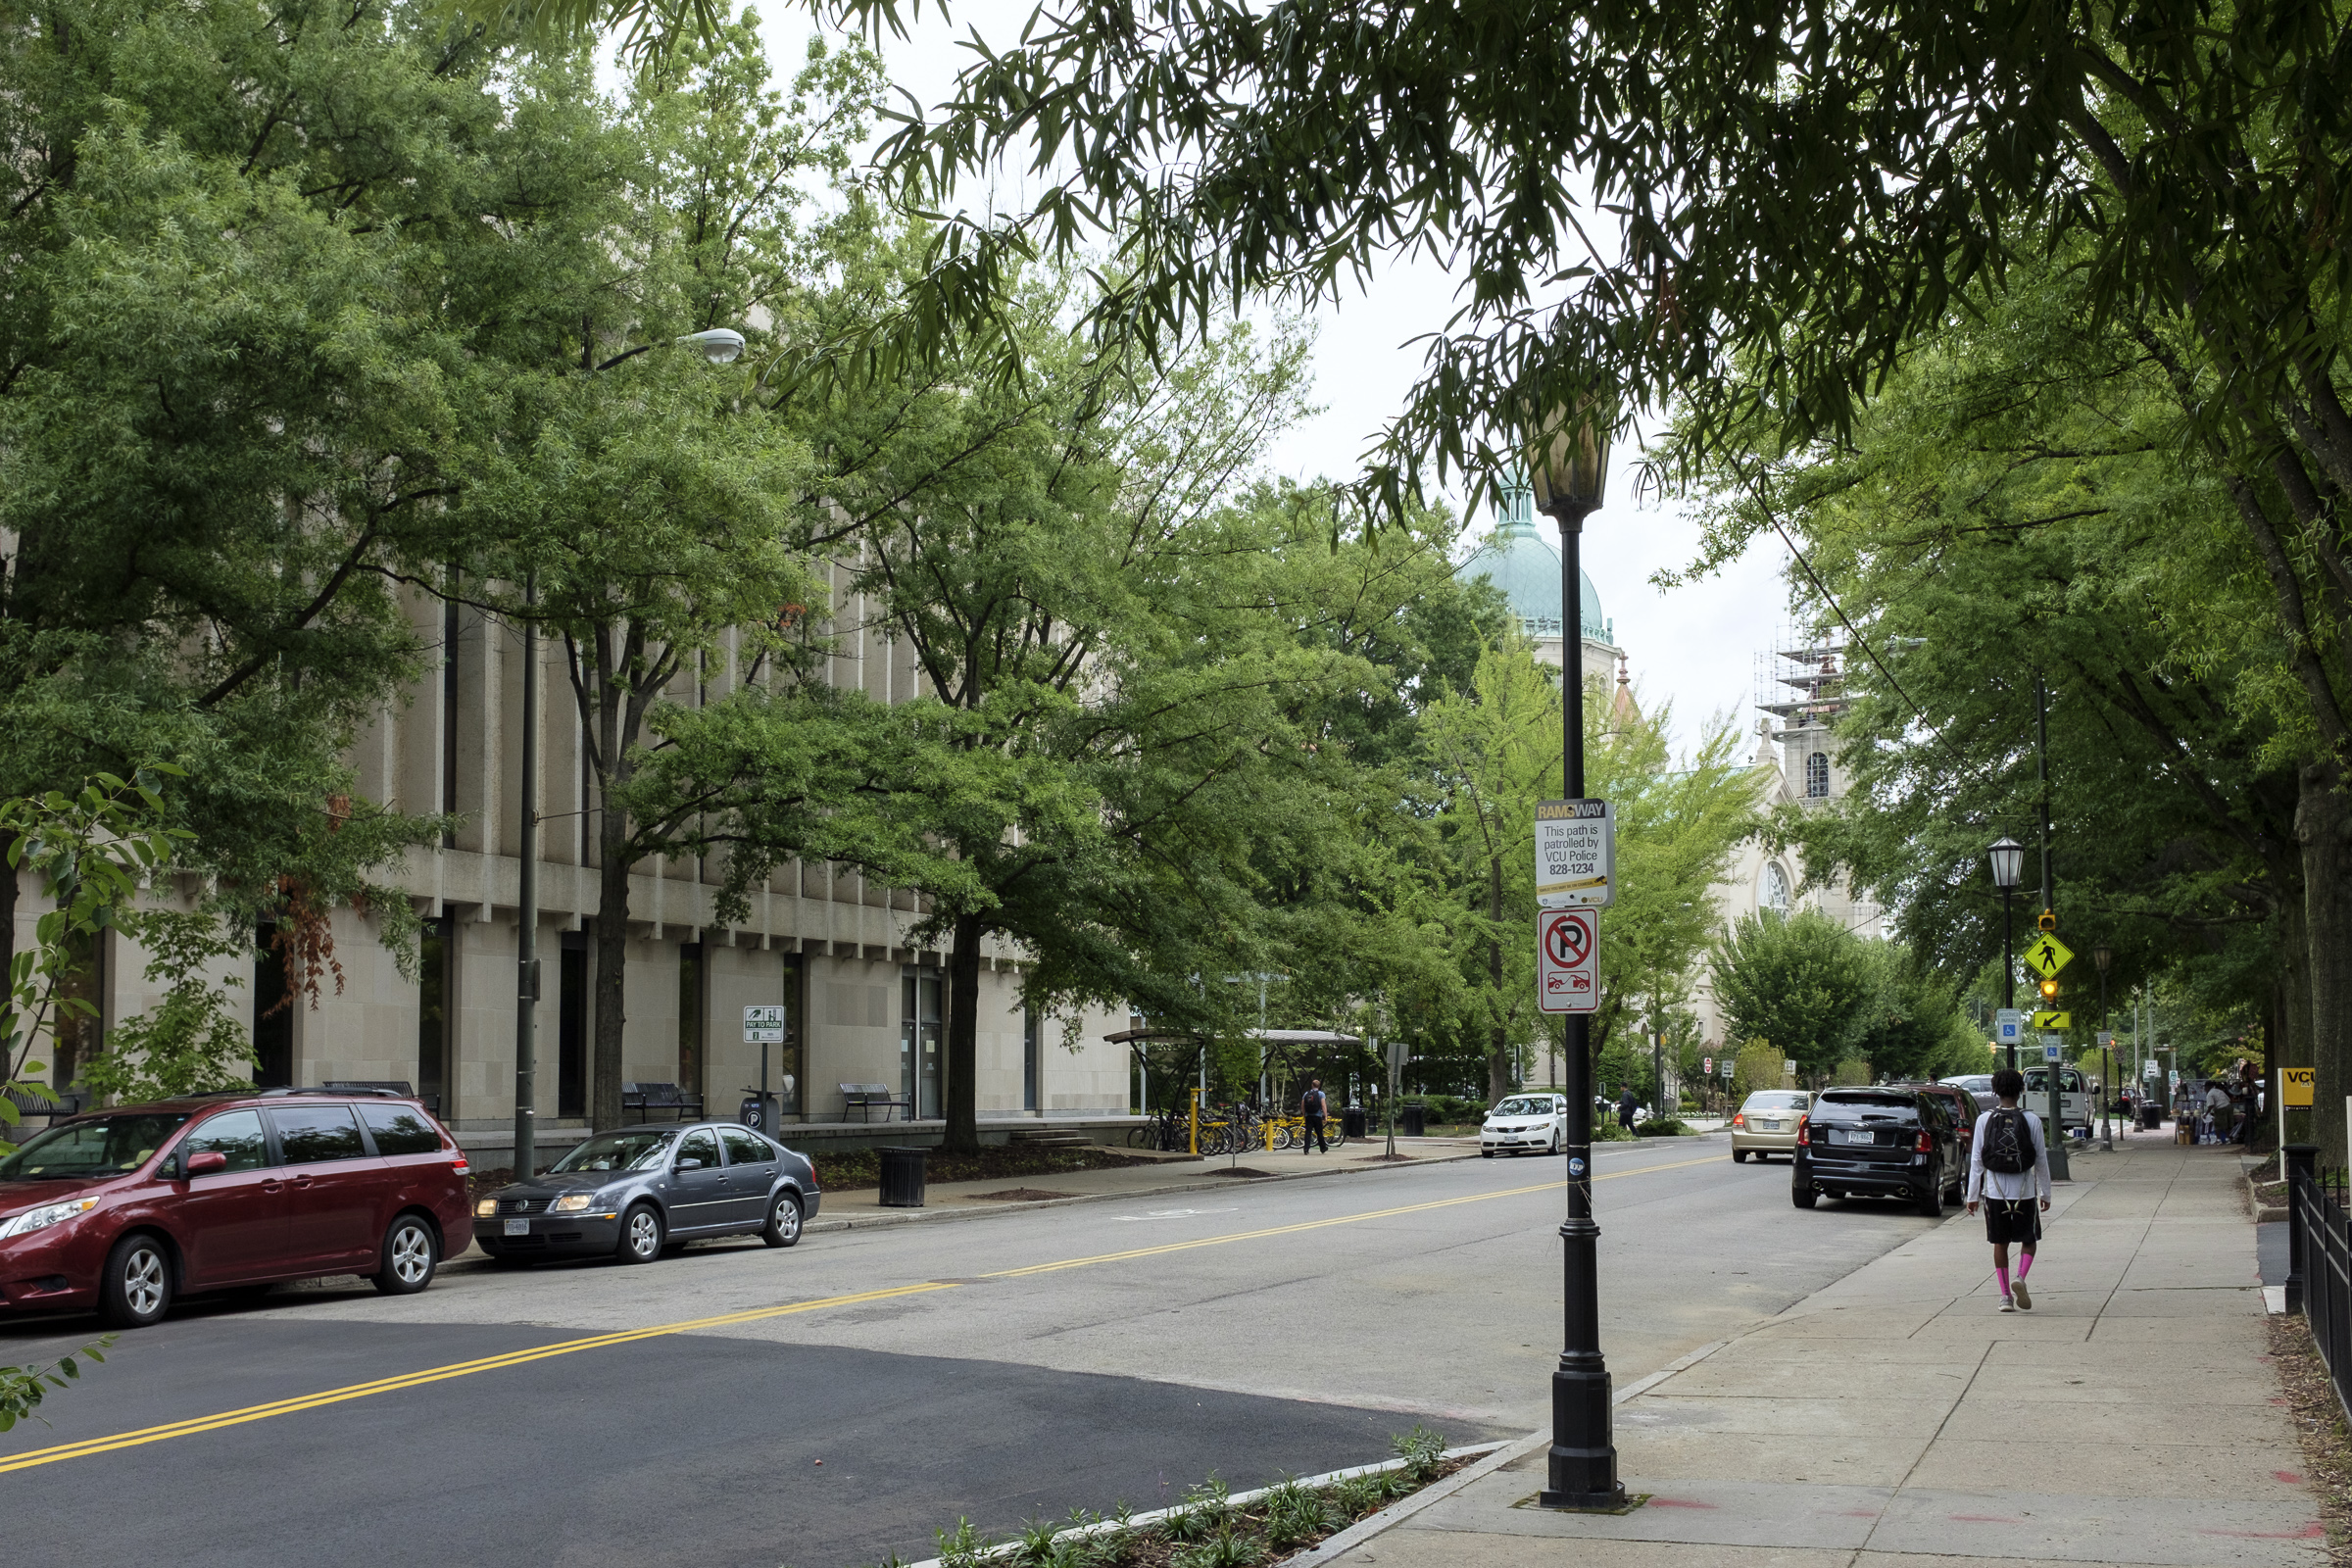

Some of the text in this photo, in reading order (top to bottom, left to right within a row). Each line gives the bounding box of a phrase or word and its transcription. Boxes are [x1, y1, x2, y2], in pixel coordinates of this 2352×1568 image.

[1539, 804, 1603, 818] RAMSWAY
[1544, 823, 1598, 838] This path is
[1544, 837, 1598, 852] patrolled by
[1544, 850, 1597, 862] VCU Police
[1549, 862, 1593, 875] 828-1234
[751, 1114, 759, 1125] P
